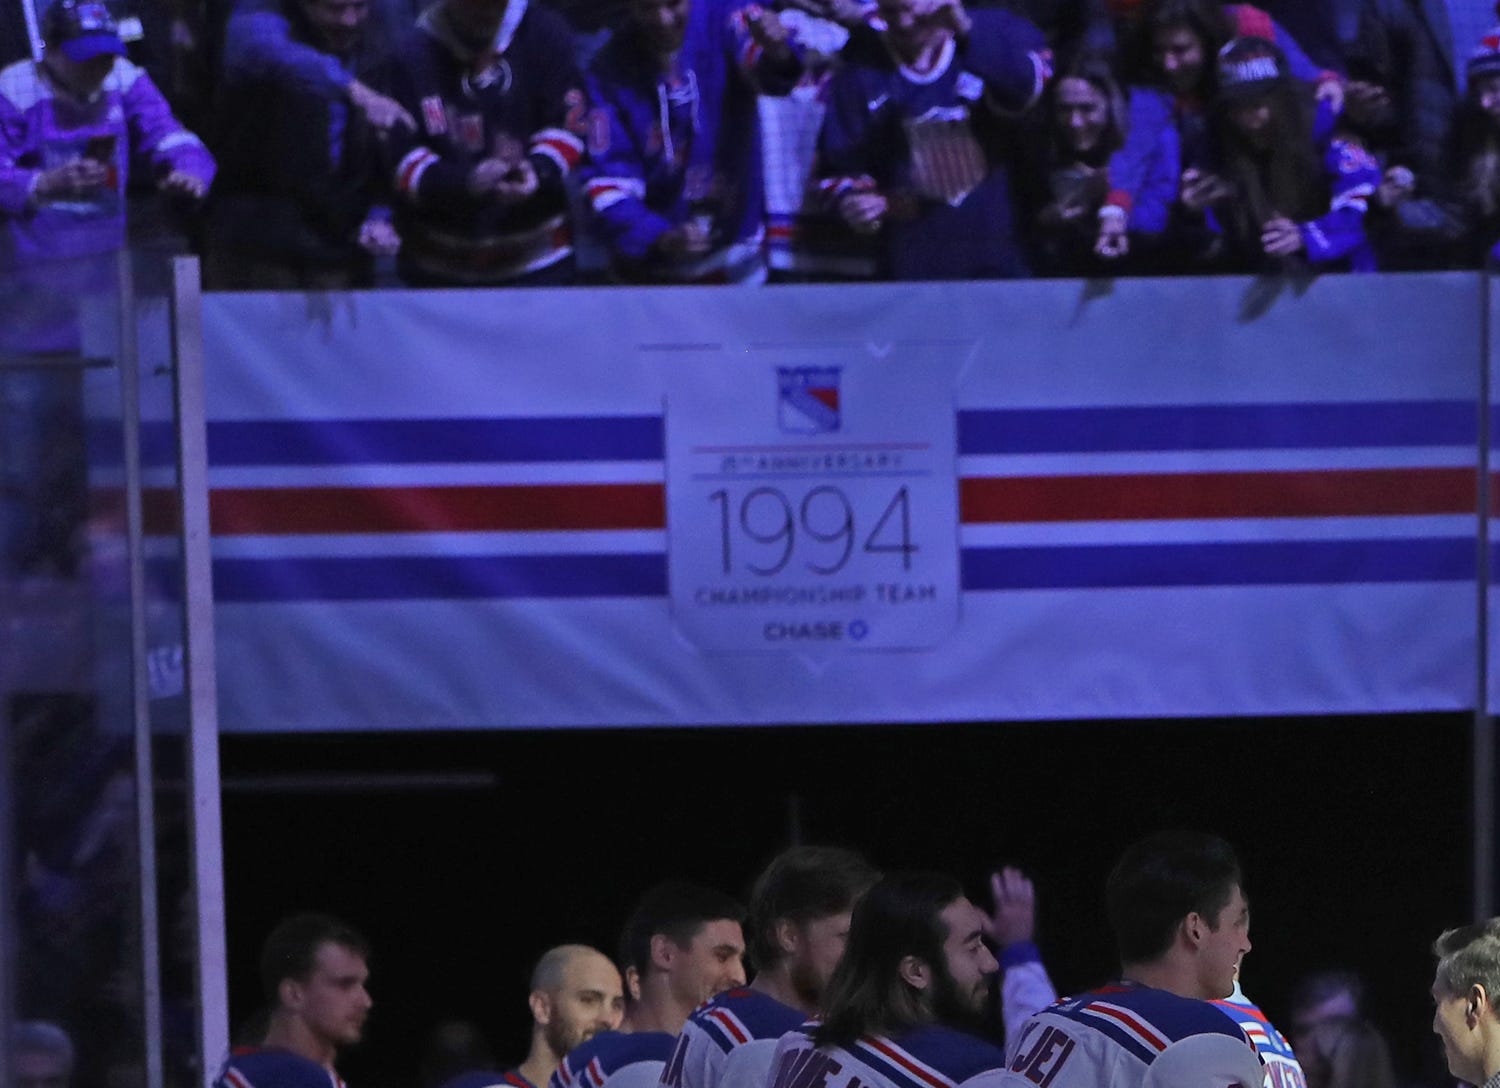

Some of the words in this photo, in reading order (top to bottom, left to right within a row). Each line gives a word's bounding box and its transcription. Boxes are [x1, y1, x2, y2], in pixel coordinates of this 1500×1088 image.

[709, 485, 920, 577] 1994
[695, 585, 866, 606] CHAMPIONSHIP
[877, 583, 936, 602] TEAM
[763, 621, 843, 642] CHASE
